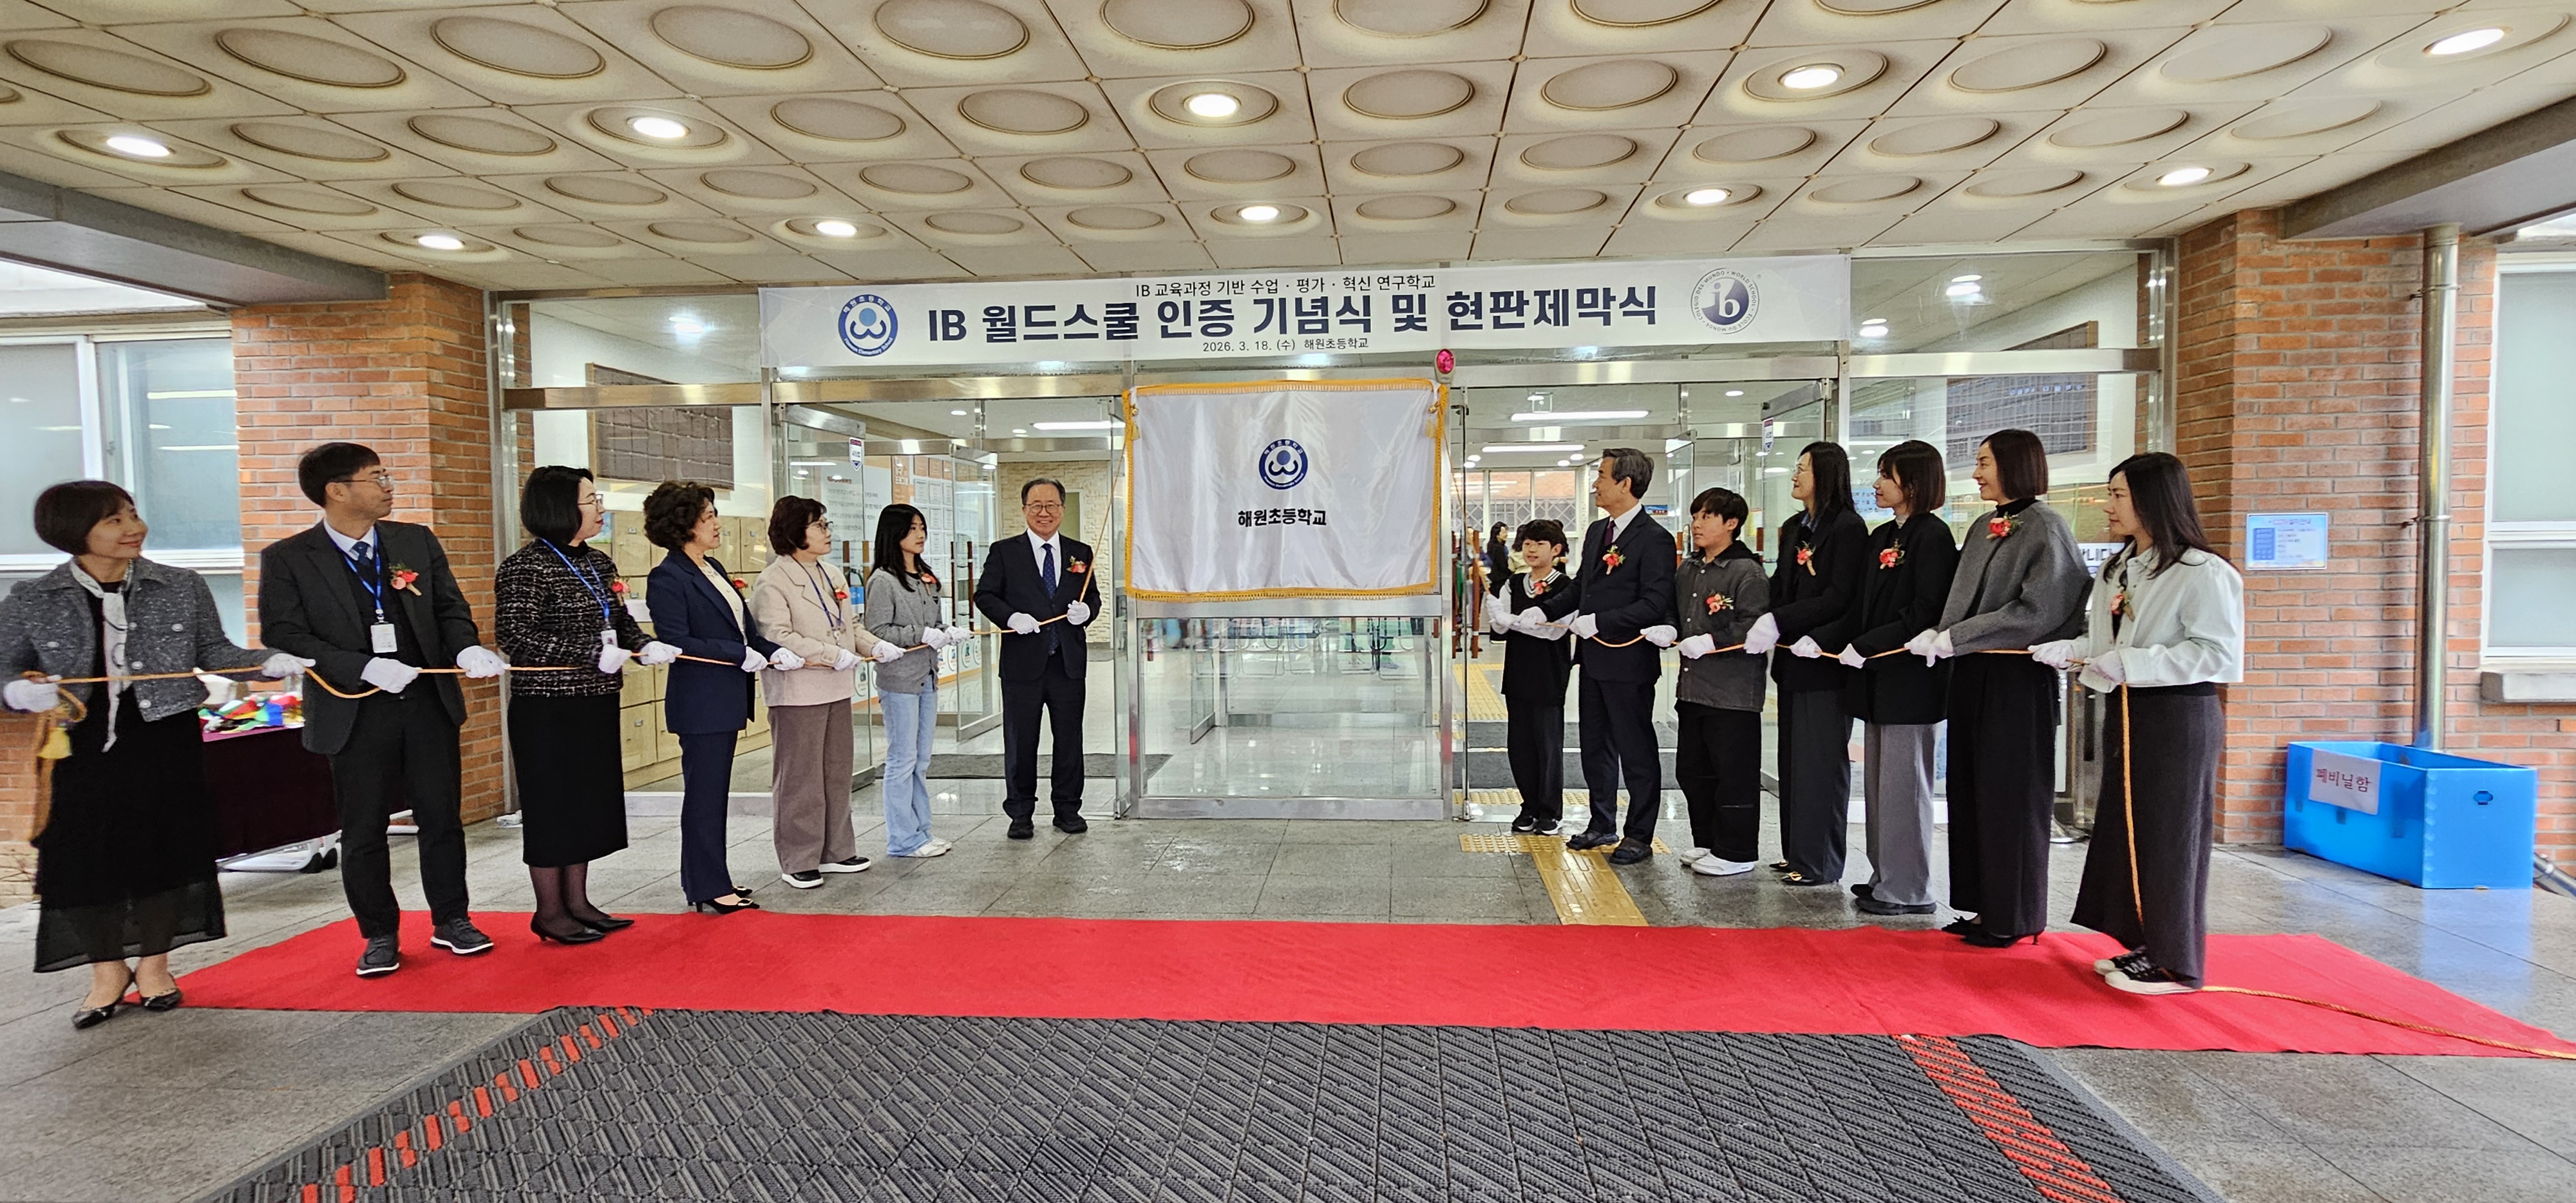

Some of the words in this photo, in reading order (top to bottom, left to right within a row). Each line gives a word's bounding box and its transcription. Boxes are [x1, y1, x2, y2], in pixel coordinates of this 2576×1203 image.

[1136, 285, 1151, 297] IB
[1155, 281, 1211, 297] 교육과정
[1217, 279, 1245, 296] 기반
[1251, 279, 1278, 295] 수업
[1296, 277, 1325, 293] 평가
[1343, 276, 1371, 292] 혁신
[1377, 274, 1435, 291] 연구학교
[1704, 270, 1725, 283] MUNDO
[1731, 271, 1750, 284] WORLD
[1748, 283, 1757, 307] SCHOOL
[929, 309, 967, 341] IB
[982, 303, 1139, 343] 월드스쿨
[1157, 299, 1235, 339] 인증
[1253, 295, 1372, 335] 기념식
[1392, 294, 1428, 332] 및
[1446, 286, 1656, 330] 현판제막식
[1203, 341, 1235, 352] 2026.
[1239, 341, 1249, 351] 3.
[1255, 340, 1271, 351] 18.
[1277, 339, 1295, 351] (수)
[1304, 337, 1368, 350] 해원초등학교
[1238, 508, 1327, 527] 해원초등학교
[2316, 768, 2371, 793] 폐비닐함
